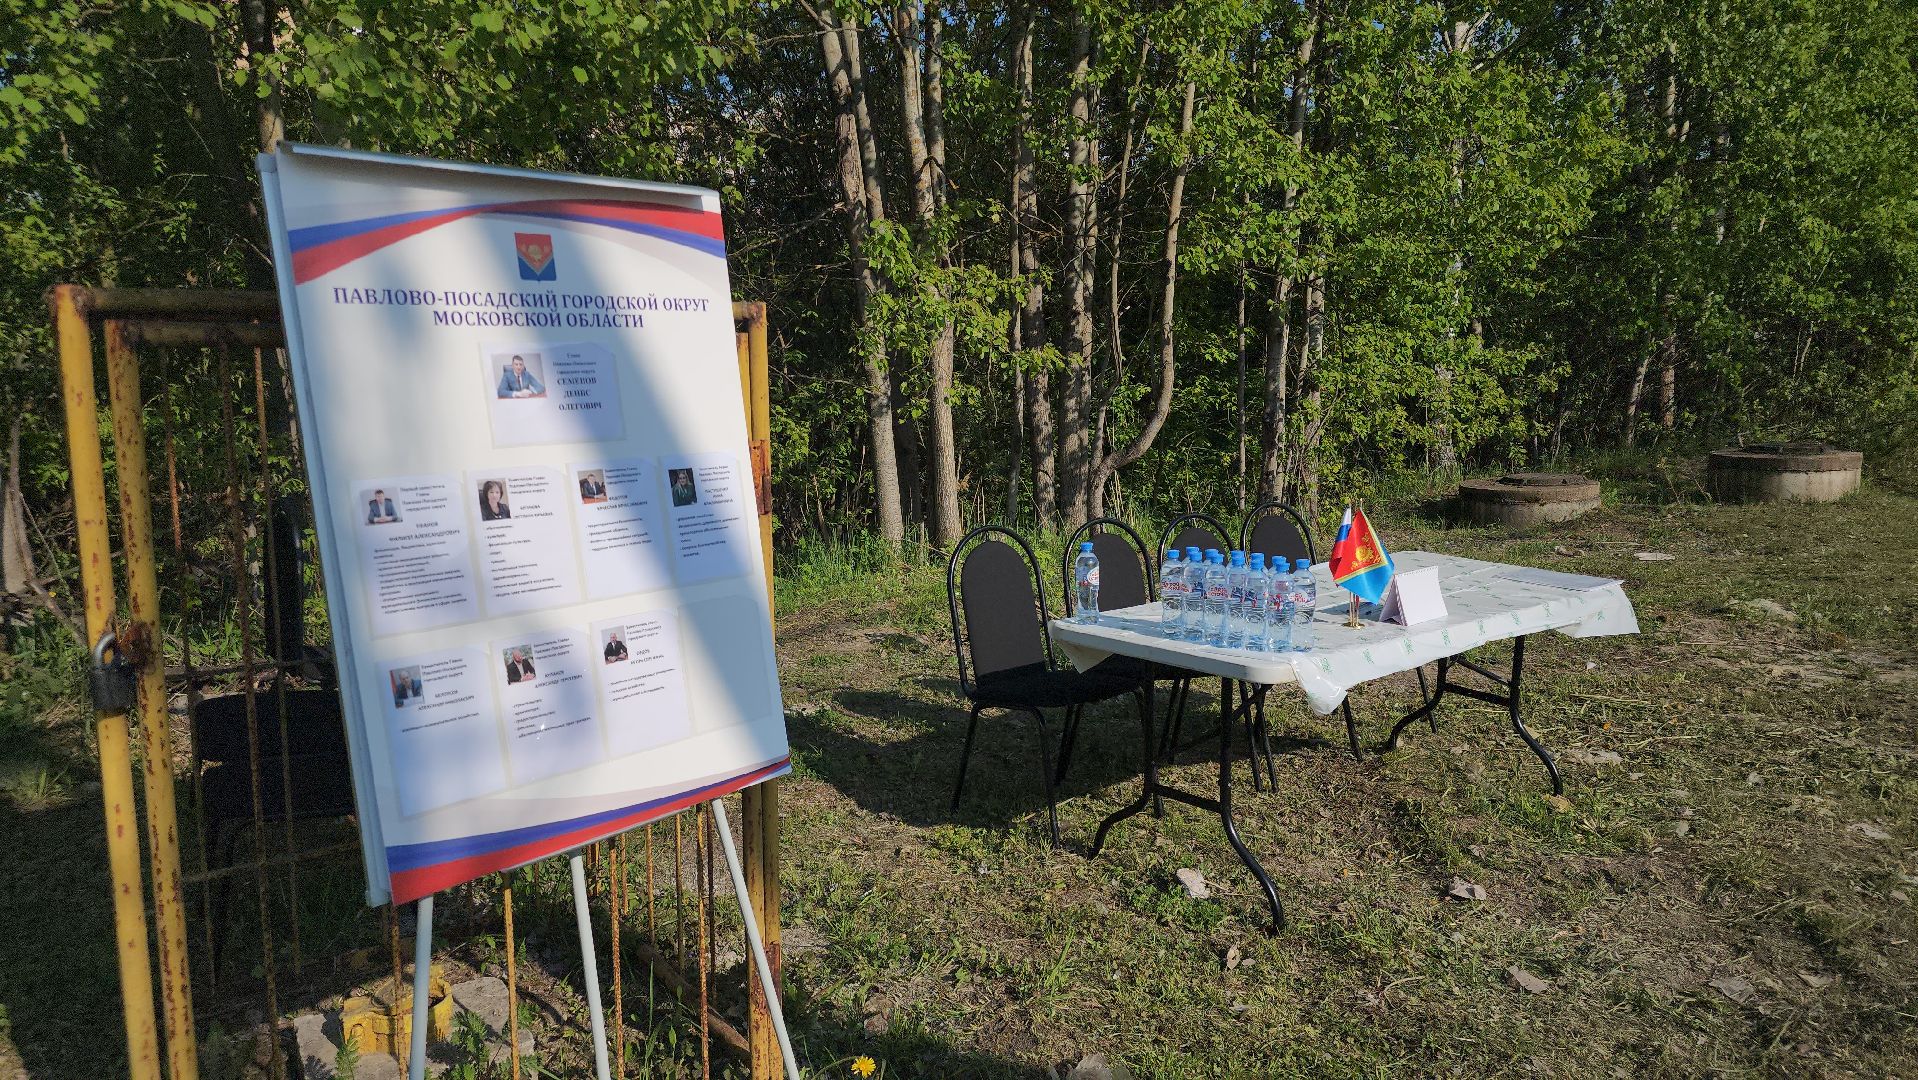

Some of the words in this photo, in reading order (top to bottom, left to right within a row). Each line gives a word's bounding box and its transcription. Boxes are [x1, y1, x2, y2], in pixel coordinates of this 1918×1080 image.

[333, 287, 558, 310] ПАВЛОВО-ПОСАДСКИЙ
[562, 293, 658, 312] ГОРОДСКОЙ
[662, 298, 709, 312] ОКРУГ
[433, 308, 562, 328] МОСКОВСКОЙ
[566, 312, 645, 328] ОБЛАСТИ
